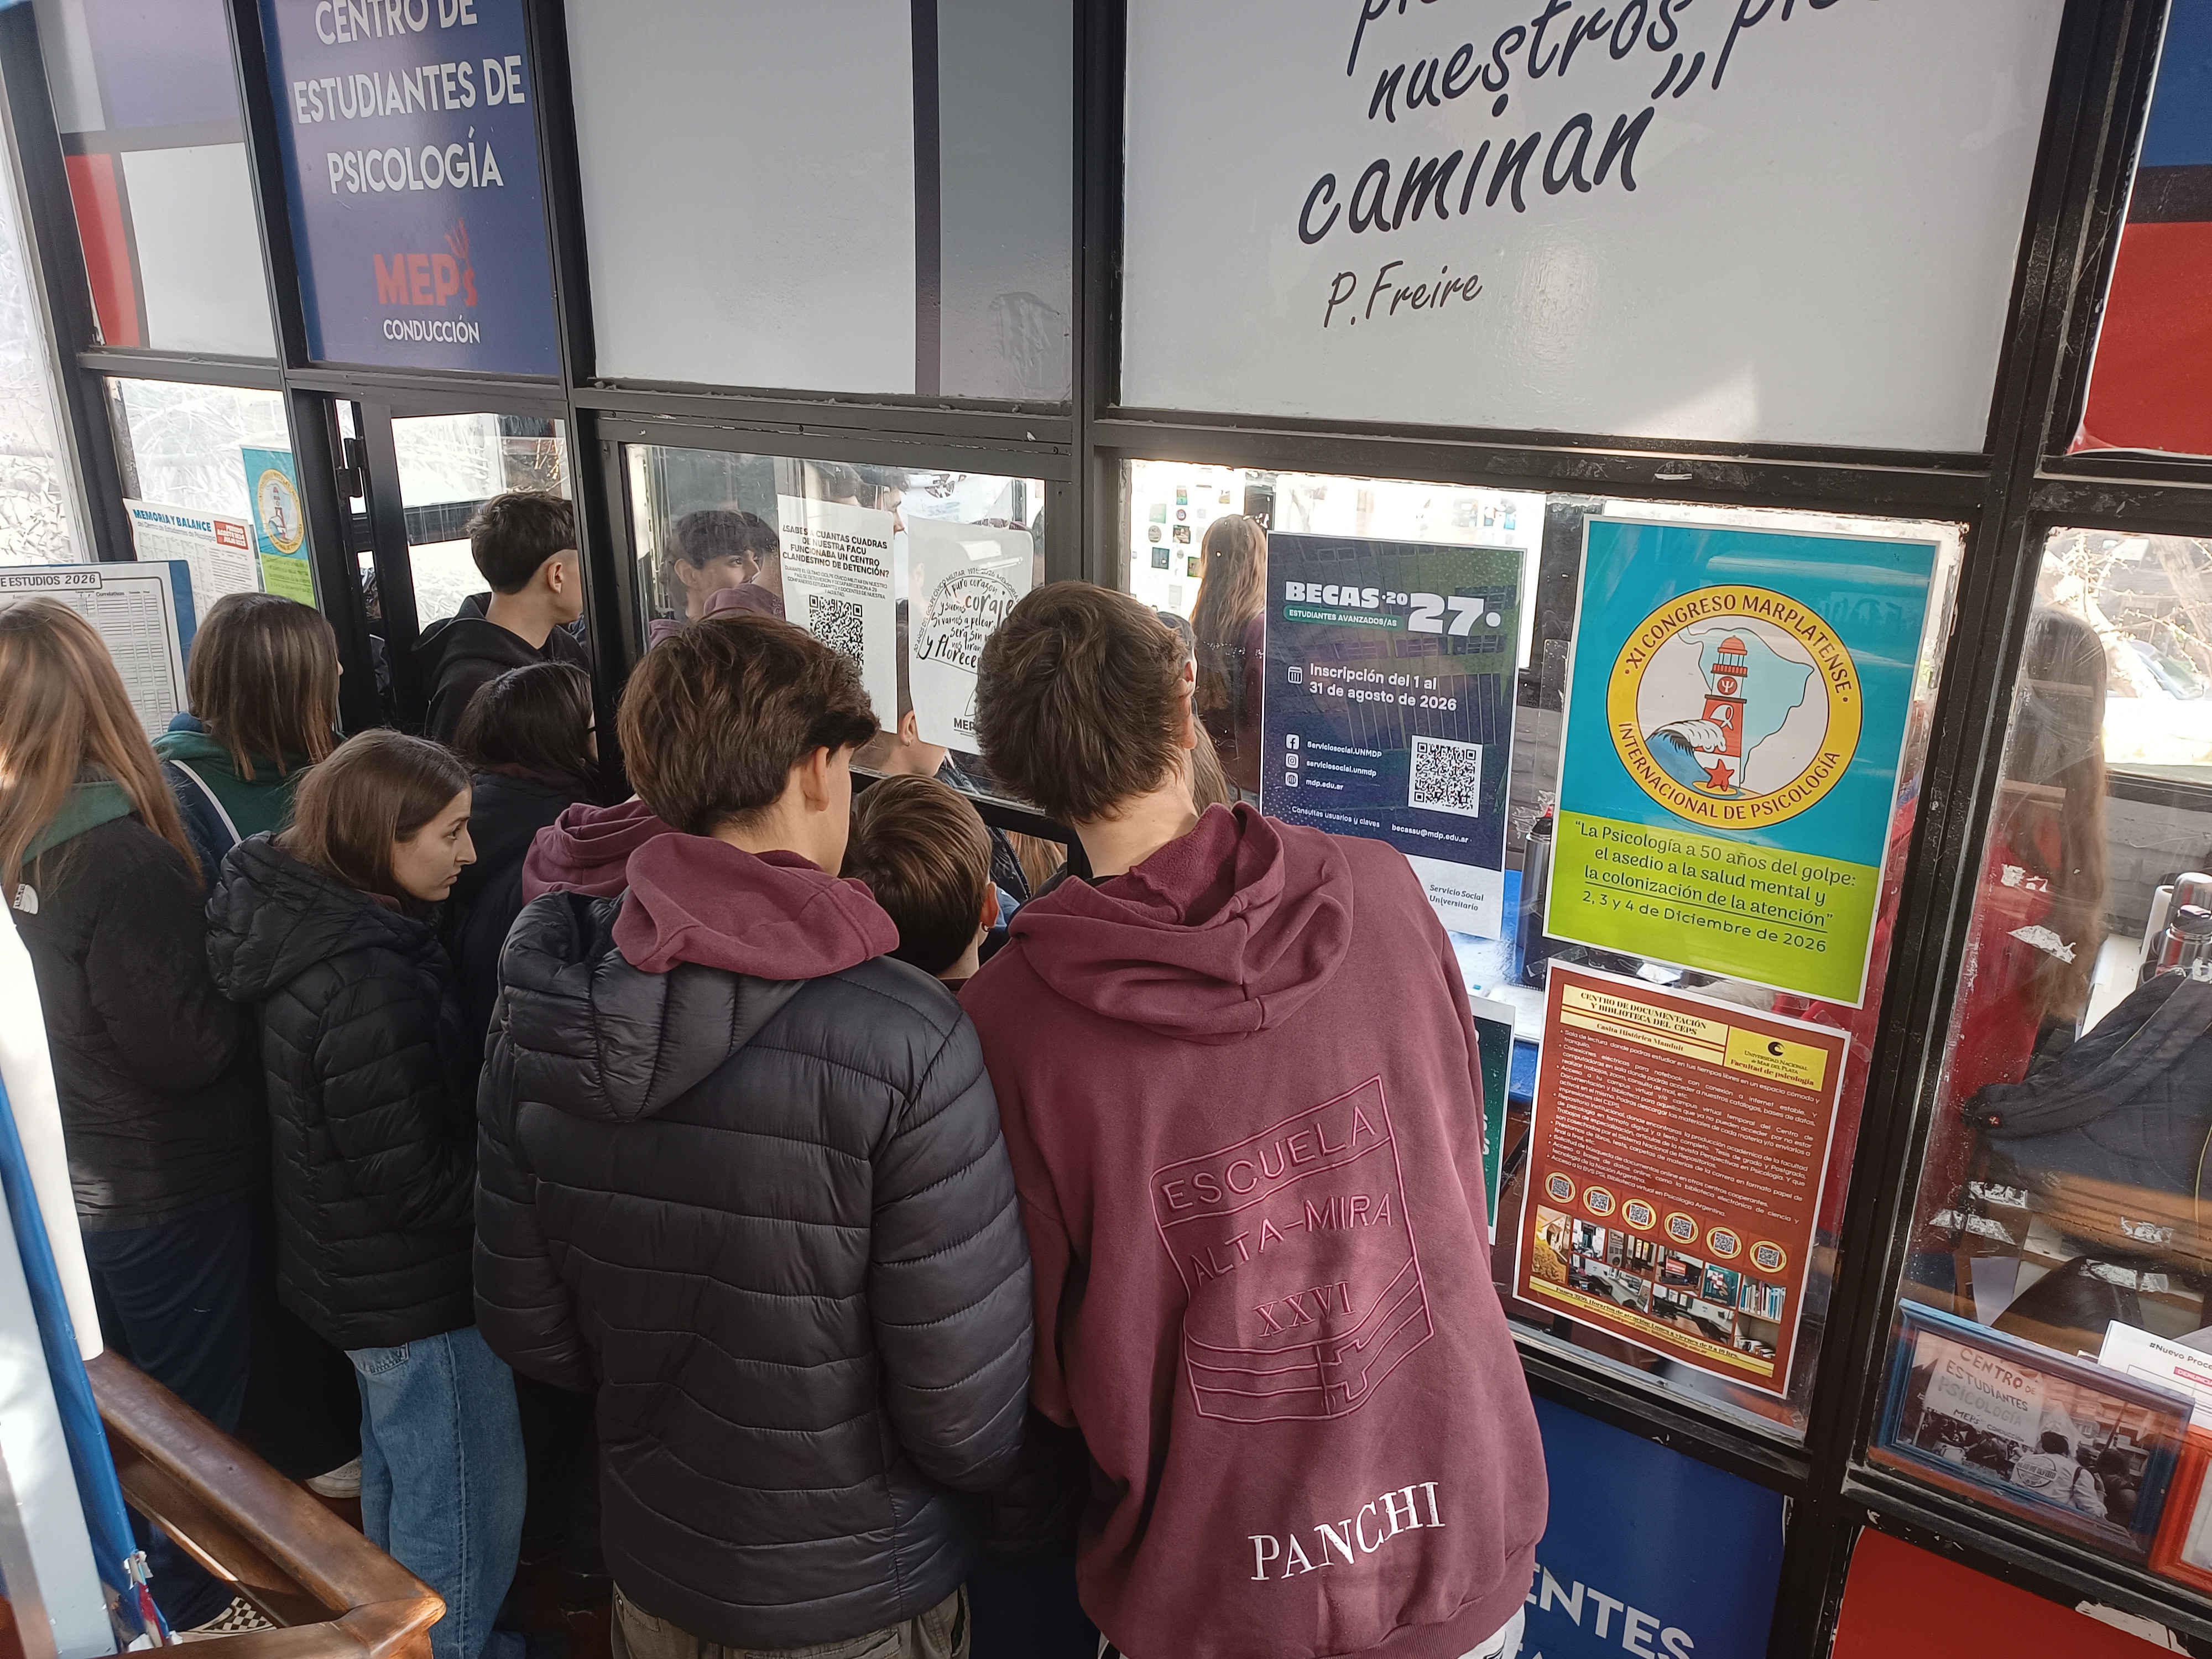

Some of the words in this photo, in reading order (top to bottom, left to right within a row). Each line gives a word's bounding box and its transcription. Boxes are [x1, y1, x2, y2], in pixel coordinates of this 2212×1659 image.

[315, 0, 429, 45] CENTRO
[437, 0, 478, 28] DE
[1368, 0, 1690, 123] nuestros
[294, 61, 477, 124] ESTUDIANTES
[483, 55, 525, 106] DE
[327, 126, 504, 195] PSICOLOGÍA
[383, 315, 480, 343] CONDUCCIÓN
[132, 509, 170, 524] MEMORIA
[169, 515, 175, 525] Y
[175, 516, 211, 532] BALANCE
[782, 524, 808, 535] ¿SABES
[816, 530, 849, 543] CUANTAS
[851, 536, 887, 549] CUADRAS
[802, 536, 810, 545] DE
[812, 539, 845, 551] NUESTRA
[846, 544, 867, 555] FACU
[782, 551, 831, 566] CLANDESTINO
[832, 560, 842, 569] DE
[842, 562, 889, 577] DETENCIÓN?
[790, 543, 836, 559] FUNCIONABA
[837, 551, 848, 561] UN
[849, 554, 880, 566] CENTRO
[8, 576, 60, 587] ESTUDIOS
[65, 575, 96, 585] 2026
[926, 596, 936, 616] GOLPE
[945, 570, 965, 582] MILITAR
[997, 574, 1018, 600] MEMORIA
[952, 578, 967, 598] puro
[1285, 581, 1379, 608] BECAS
[942, 615, 962, 625] vamos
[965, 591, 1014, 629] coraje
[1288, 609, 1337, 620] ESTUDIANTES
[1337, 614, 1397, 627] AVANZADOS/AS
[968, 629, 982, 642] sin
[1625, 646, 1646, 670] XI
[1642, 593, 1736, 649] CONGRESO
[1742, 594, 1851, 695] MARPLATENSE
[1310, 663, 1384, 683] Inscripción
[1387, 672, 1410, 687] del
[1413, 675, 1420, 688] 1
[1423, 677, 1437, 690] al
[1309, 681, 1323, 694] 31
[1327, 684, 1344, 697] de
[1347, 688, 1394, 703] agosto
[1397, 692, 1416, 706] de
[1420, 695, 1457, 711] 2026
[1305, 779, 1343, 790] mdp.edu.ar
[1618, 722, 1718, 819] INTERNACIONAL
[1724, 805, 1747, 820] DE
[1751, 750, 1840, 818] PSICOLOGÍA
[1291, 805, 1323, 817] Consultas
[1324, 812, 1352, 822] usuarios
[1602, 826, 1681, 854] Psicología
[1685, 844, 1696, 857] a
[1699, 844, 1721, 861] 50
[1725, 852, 1766, 870] años
[1771, 858, 1797, 876] del
[1801, 867, 1855, 886] golpe:
[1584, 864, 1598, 880] la
[1602, 872, 1702, 900] colonización
[1706, 890, 1726, 906] de
[1730, 894, 1746, 910] la
[1594, 846, 1608, 860] el
[1611, 852, 1663, 870] asedio
[1667, 862, 1677, 874] a
[1682, 862, 1697, 878] la
[1700, 869, 1745, 888] salud
[1750, 879, 1810, 900] mental
[1814, 891, 1825, 907] y
[1430, 884, 1460, 898] Servicio
[1462, 890, 1484, 902] Social
[1430, 895, 1479, 911] Universitario
[1582, 890, 1594, 905] 2,
[1599, 893, 1608, 905] 3
[1612, 899, 1621, 910] y
[1625, 899, 1634, 911] 4
[1639, 903, 1659, 917] de
[1664, 907, 1751, 936] Diciembre
[1756, 928, 1778, 942] de
[1782, 932, 1825, 952] 2026
[1580, 992, 1615, 1005] CENTRO
[1616, 1000, 1629, 1009] DE
[1630, 1004, 1706, 1029] DOCUMENTACIÓN
[1598, 1004, 1651, 1023] BIBLIOTECA
[1652, 1018, 1671, 1029] DEL
[1673, 1023, 1697, 1035] CEPS
[1596, 1023, 1618, 1034] Casita
[1730, 1058, 1762, 1072] Facultad
[1775, 1072, 1814, 1086] psicología
[1744, 1050, 1779, 1063] UNIVERSIDAD
[1779, 1059, 1808, 1071] NACIONAL
[1781, 1065, 1798, 1074] PLATA
[1162, 1106, 1375, 1212] ESCUELA
[1191, 1193, 1392, 1287] ALTA-MIRA
[1253, 1281, 1356, 1337] XXVI
[2149, 1342, 2184, 1359] #Nuevo
[1960, 1347, 2026, 1389] CENTRO
[2024, 1385, 2036, 1395] DE
[1248, 1481, 1446, 1580] PANCHI
